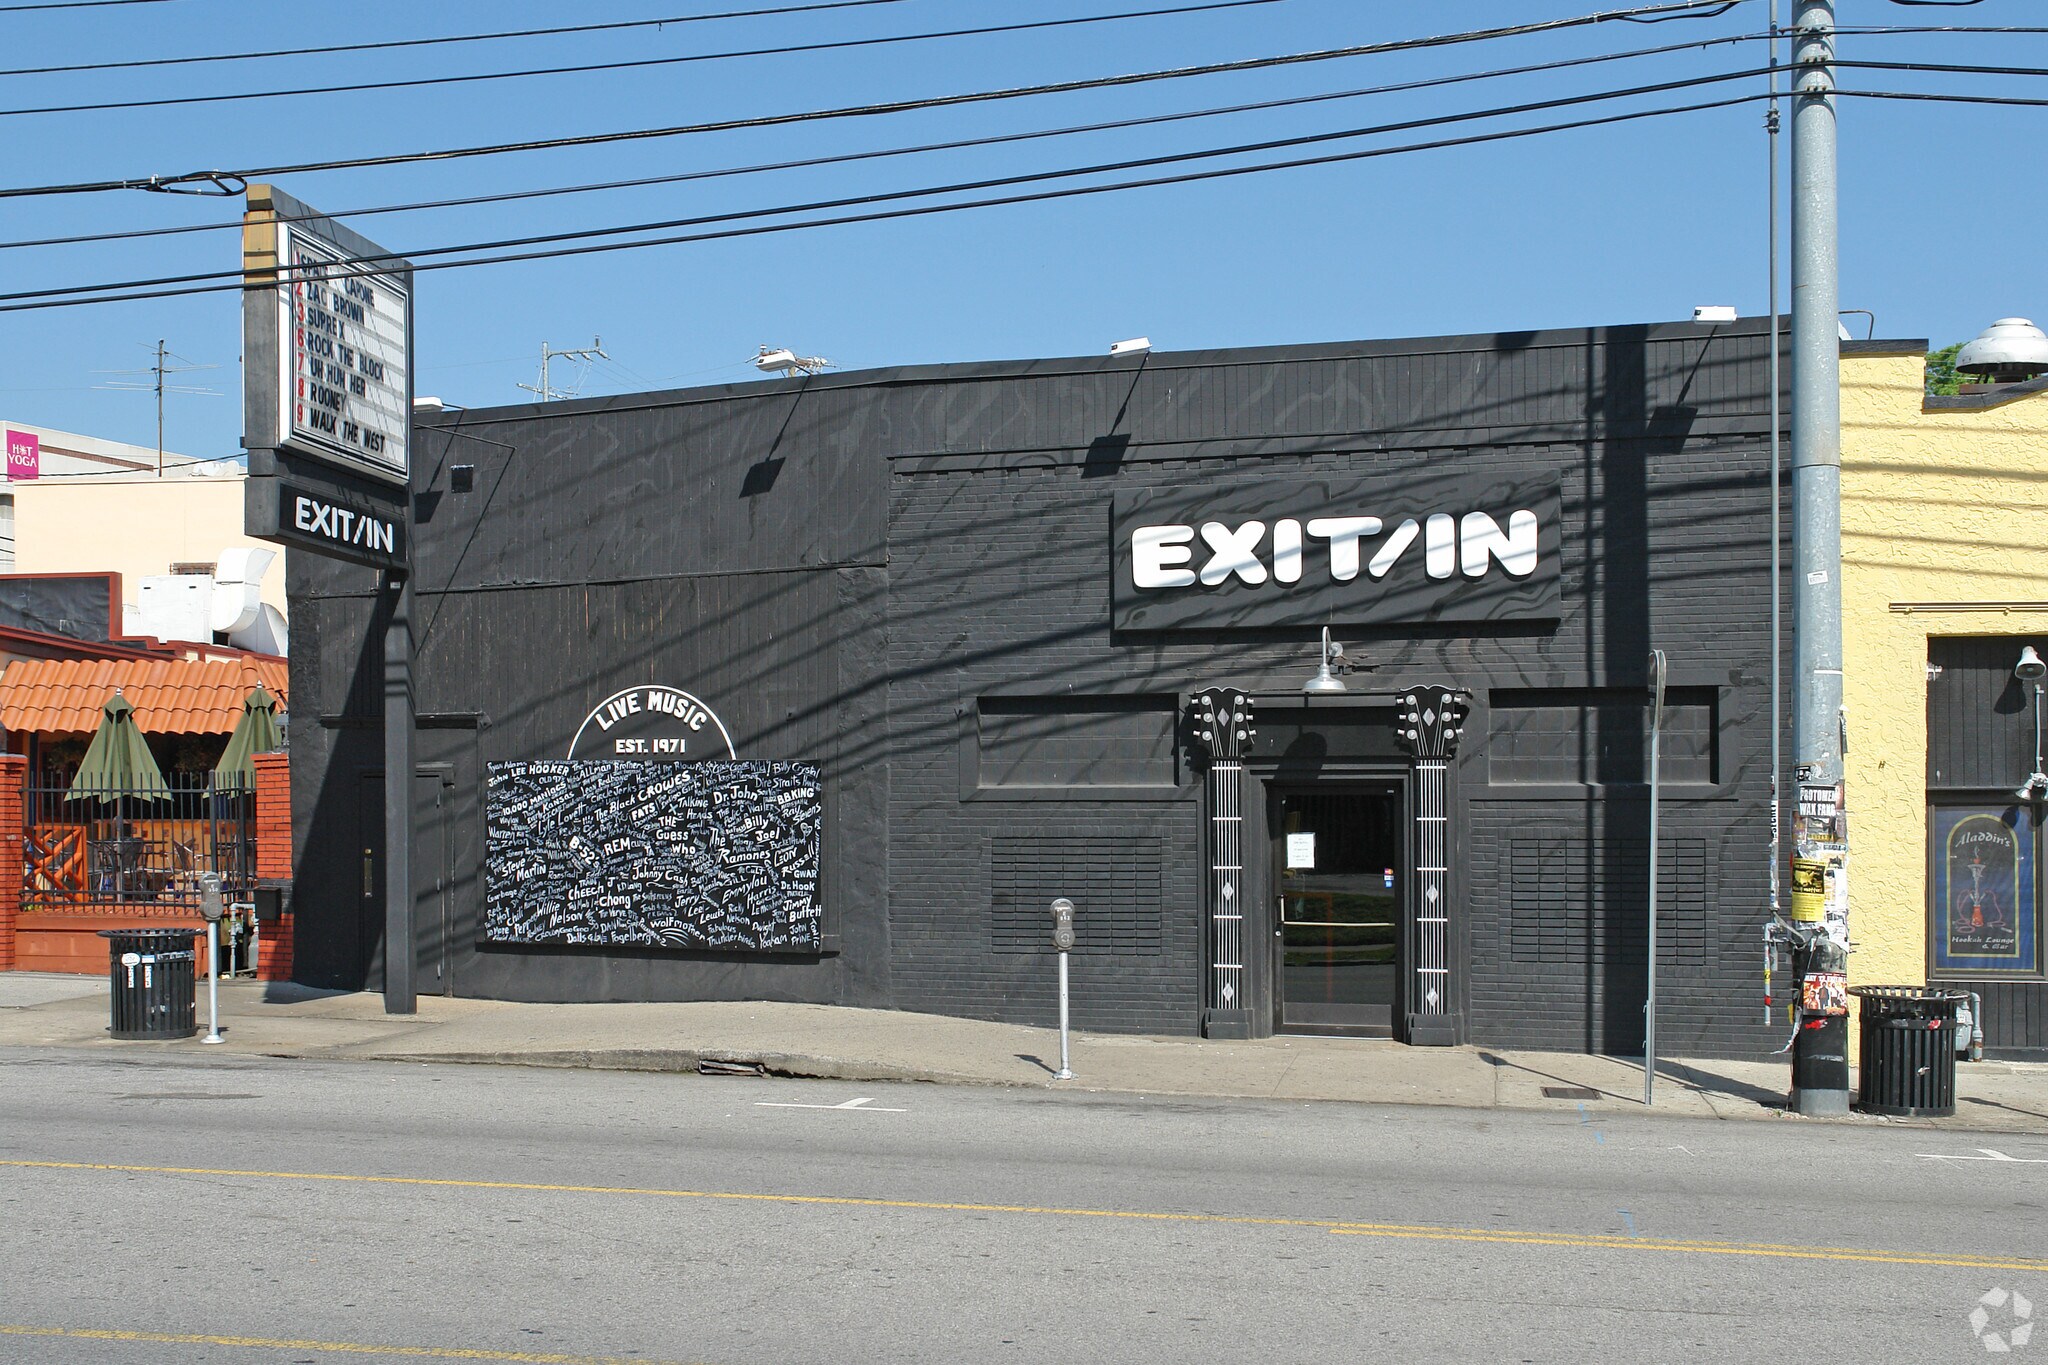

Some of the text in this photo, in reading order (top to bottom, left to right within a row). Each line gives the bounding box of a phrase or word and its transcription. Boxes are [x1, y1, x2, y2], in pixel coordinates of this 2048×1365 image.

[345, 277, 374, 307] CAPONE
[297, 302, 304, 321] 3
[307, 280, 328, 306] ZAC
[333, 292, 365, 325] BROWN
[297, 328, 384, 382] 6 ROCK THE BLOCK
[298, 352, 365, 397] 7 UH HUH HER
[298, 378, 304, 397] 8
[297, 404, 385, 453] 9 WALK THE WEST
[8, 452, 37, 468] YOGA
[295, 496, 394, 554] EXIT/IN
[1131, 509, 1538, 588] EXIT/IN
[595, 690, 707, 731] LIVE MUSIC
[616, 738, 686, 754] EST. 1971
[488, 764, 569, 787] John LEE HOOKER
[539, 776, 552, 784] OLD
[755, 775, 801, 788] Dire Straits
[594, 770, 690, 820] The Black CROWES
[713, 785, 758, 804] Dr. John
[502, 801, 527, 816] 10,000
[632, 803, 656, 820] FATS
[538, 818, 556, 838] Lyle
[658, 816, 677, 828] THE
[744, 814, 769, 830] Billy
[488, 826, 515, 840] Warren
[656, 830, 689, 841] Guess
[755, 827, 780, 841] Joel
[1955, 831, 2011, 847] Aladdin's
[604, 837, 630, 856] REM
[672, 843, 696, 855] Who
[717, 848, 770, 864] Ramones
[502, 858, 526, 877] Steve
[516, 862, 546, 882] Martin
[632, 865, 688, 888] Johnny Cash
[794, 870, 817, 878] GWAR
[487, 889, 518, 902] Garbage
[599, 890, 630, 909] Chong
[675, 894, 700, 908] Jerry
[550, 908, 583, 928] Nelson
[1985, 936, 2014, 944] Lounge
